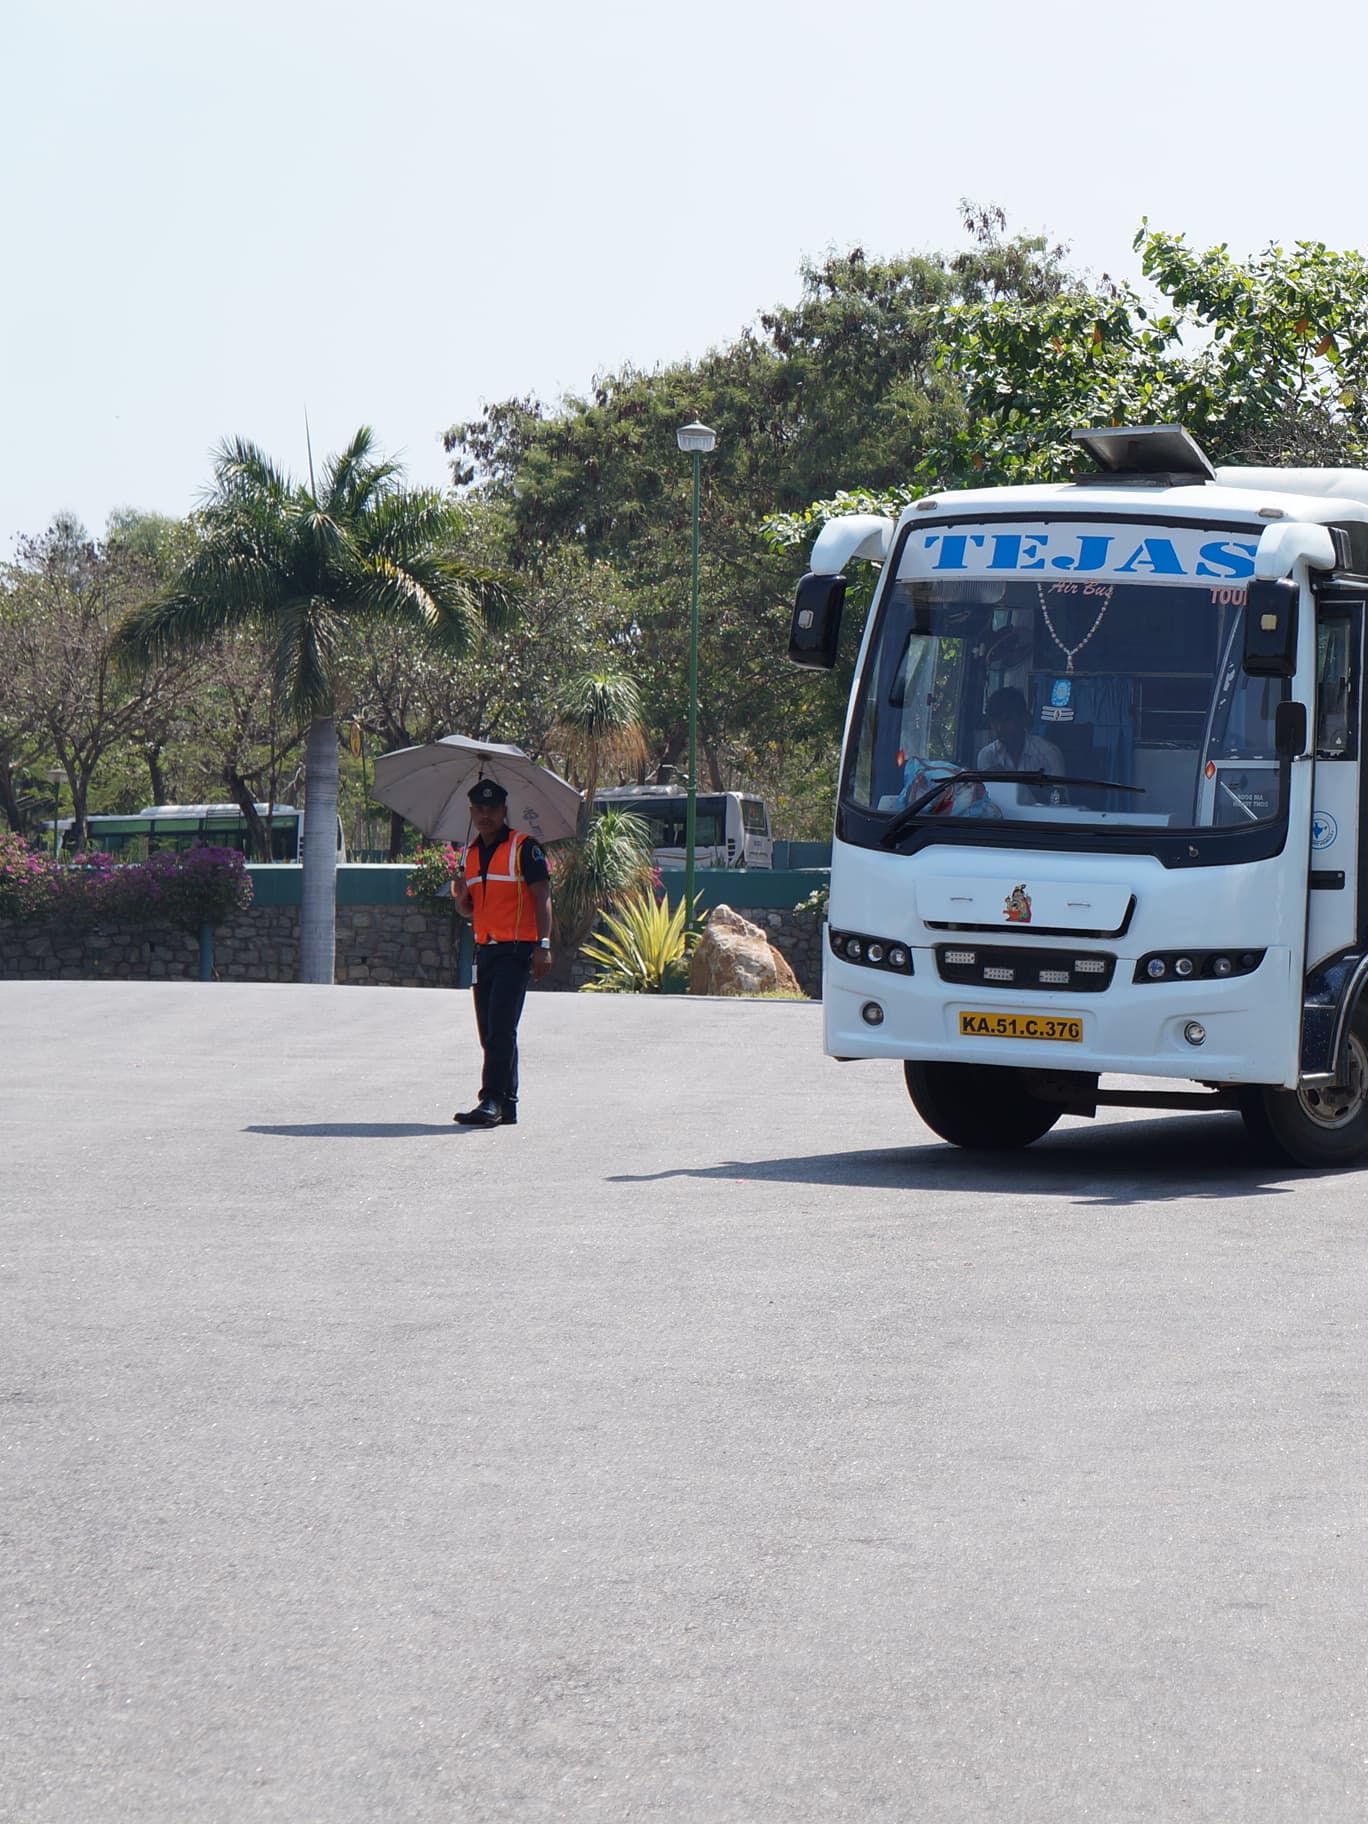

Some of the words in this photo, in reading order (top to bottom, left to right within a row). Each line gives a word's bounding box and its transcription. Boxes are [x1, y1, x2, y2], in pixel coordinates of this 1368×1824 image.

[924, 535, 1257, 579] TEJAS
[1048, 577, 1078, 594] Air
[1210, 586, 1247, 606] TOU
